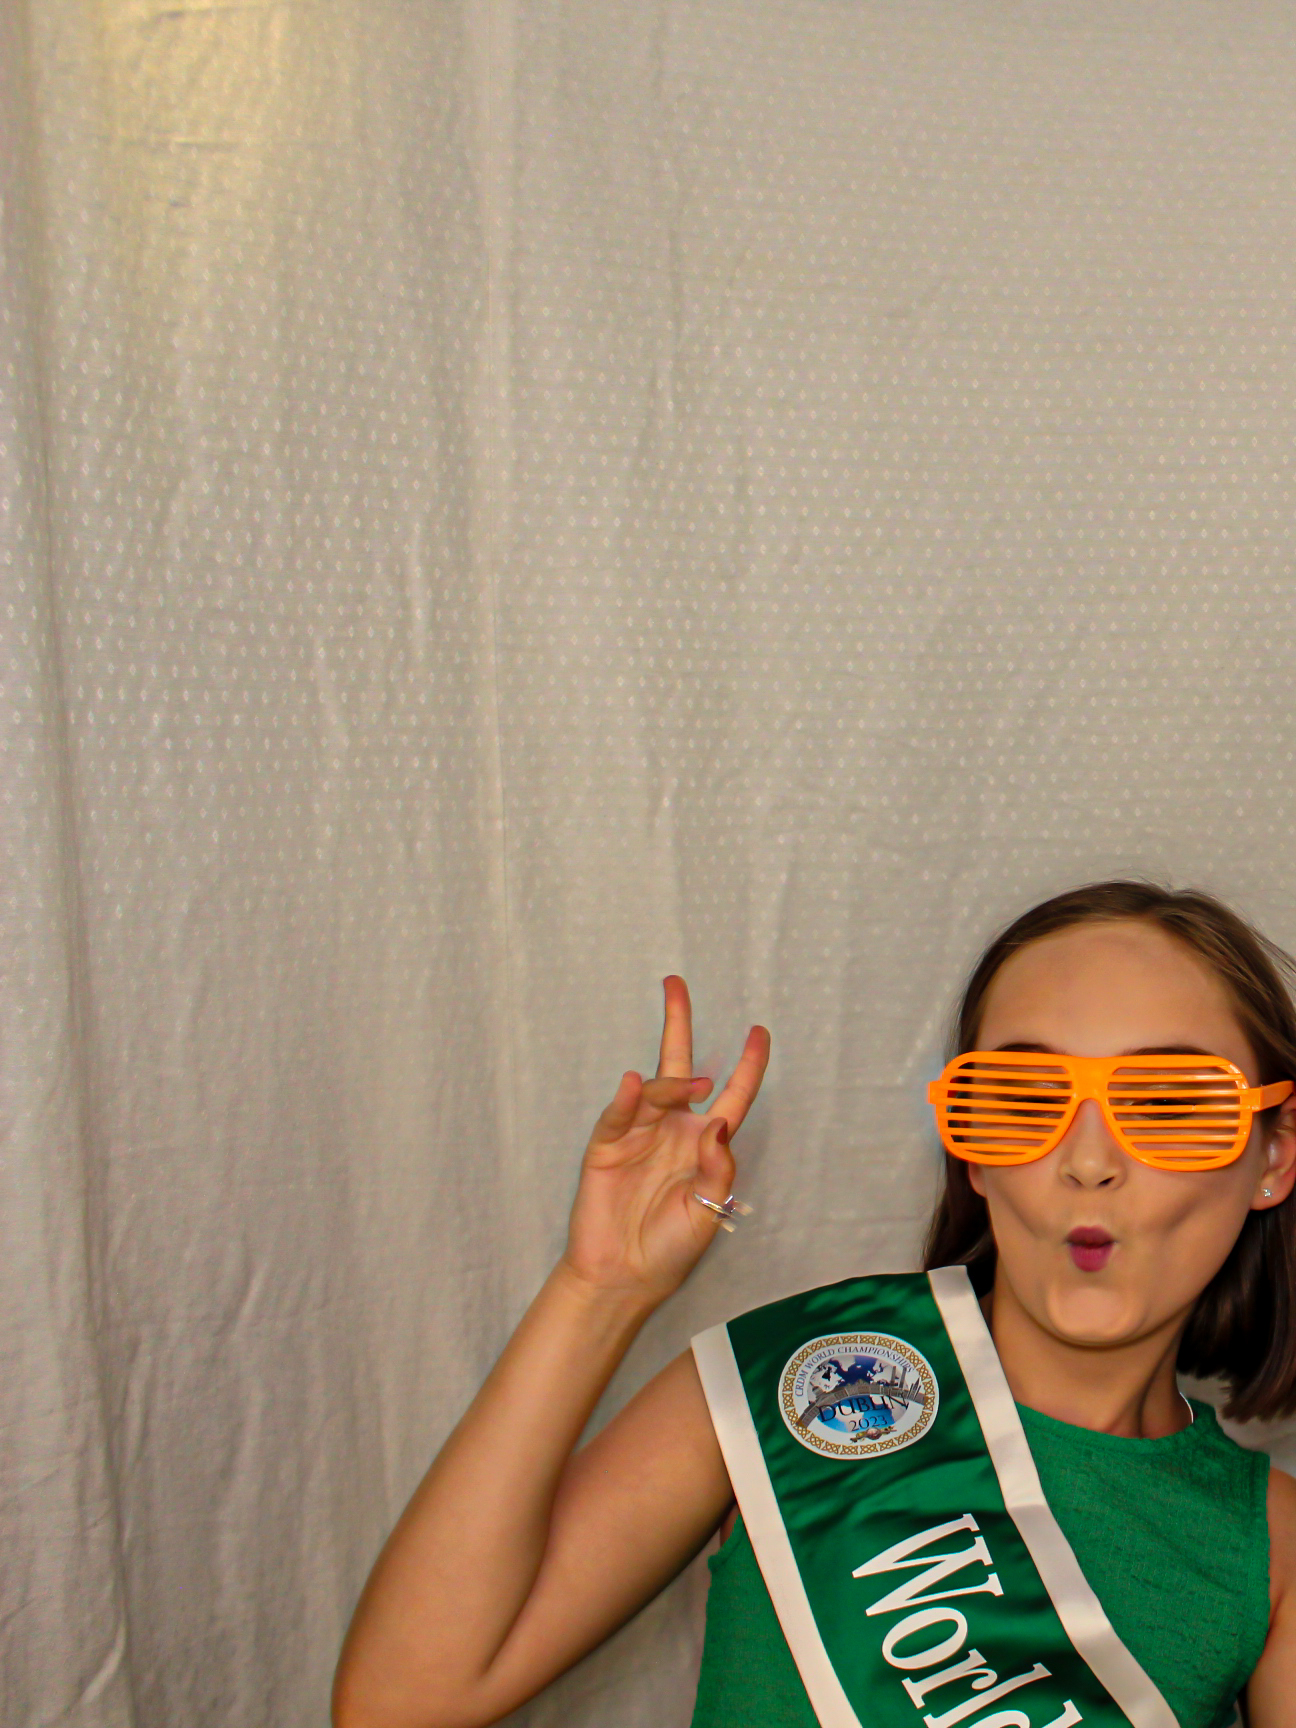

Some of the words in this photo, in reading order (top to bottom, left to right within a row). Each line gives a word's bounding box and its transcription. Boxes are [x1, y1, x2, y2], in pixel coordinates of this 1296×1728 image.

[794, 1370, 809, 1397] CRDM
[805, 1348, 835, 1371] WORLD
[837, 1346, 915, 1373] CHAMPIONSHIPS
[817, 1394, 910, 1423] DUBLIN
[848, 1415, 888, 1432] 2023
